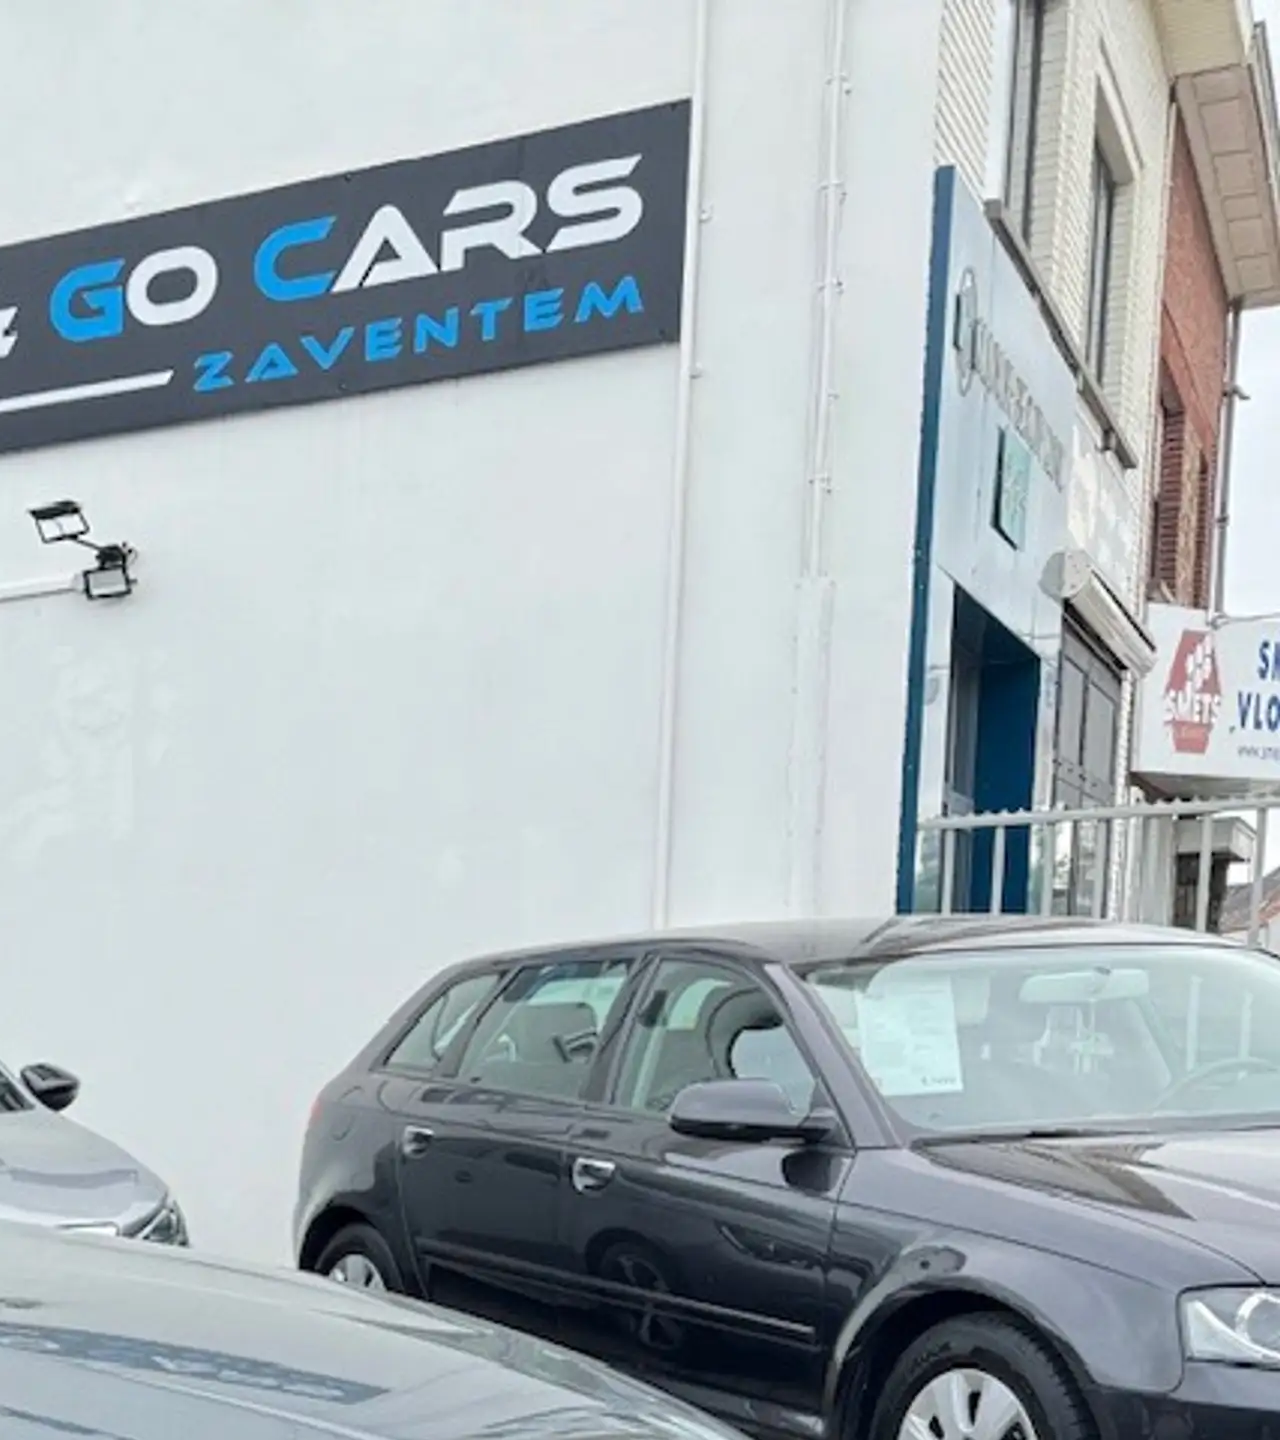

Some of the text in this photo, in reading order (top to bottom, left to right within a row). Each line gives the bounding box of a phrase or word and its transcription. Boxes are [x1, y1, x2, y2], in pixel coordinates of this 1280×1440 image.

[49, 244, 219, 343] GO
[252, 154, 644, 297] CARS
[192, 274, 644, 393] ZAVENTEM
